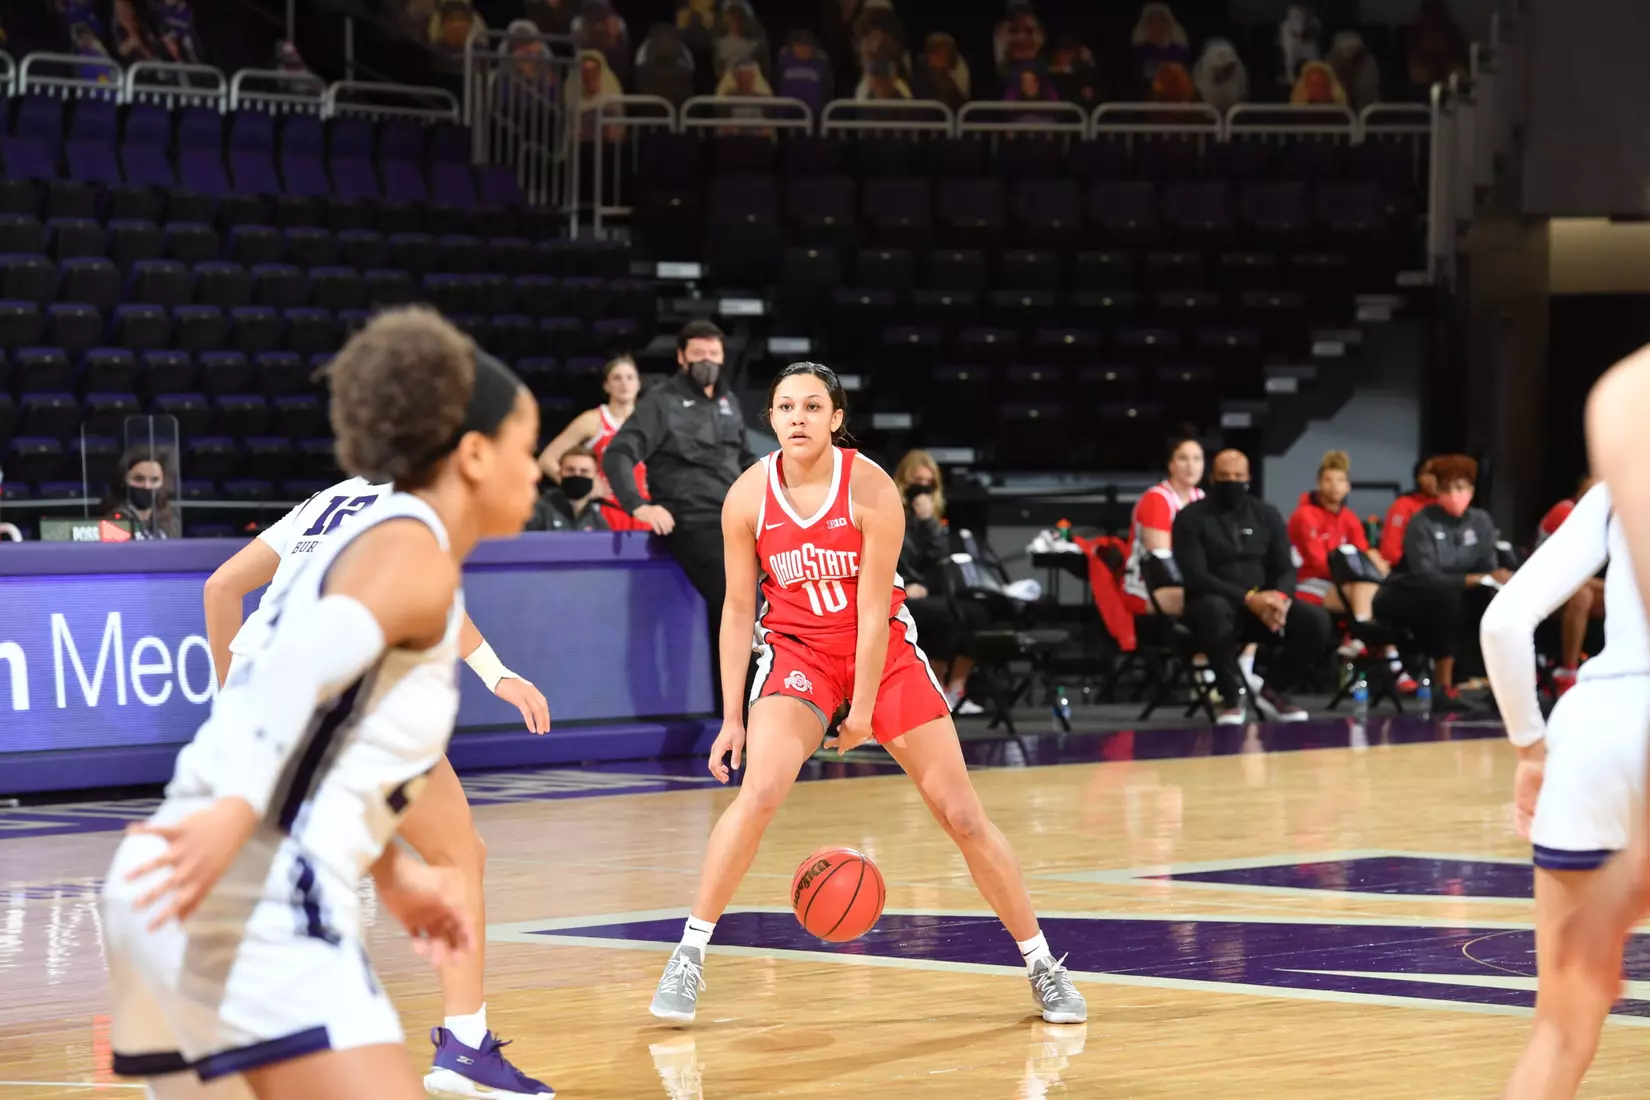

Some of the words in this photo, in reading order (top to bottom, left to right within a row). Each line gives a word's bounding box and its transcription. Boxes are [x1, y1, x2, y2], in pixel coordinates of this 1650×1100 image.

[302, 494, 379, 536] 12
[291, 541, 323, 554] BUR
[802, 580, 849, 616] 10
